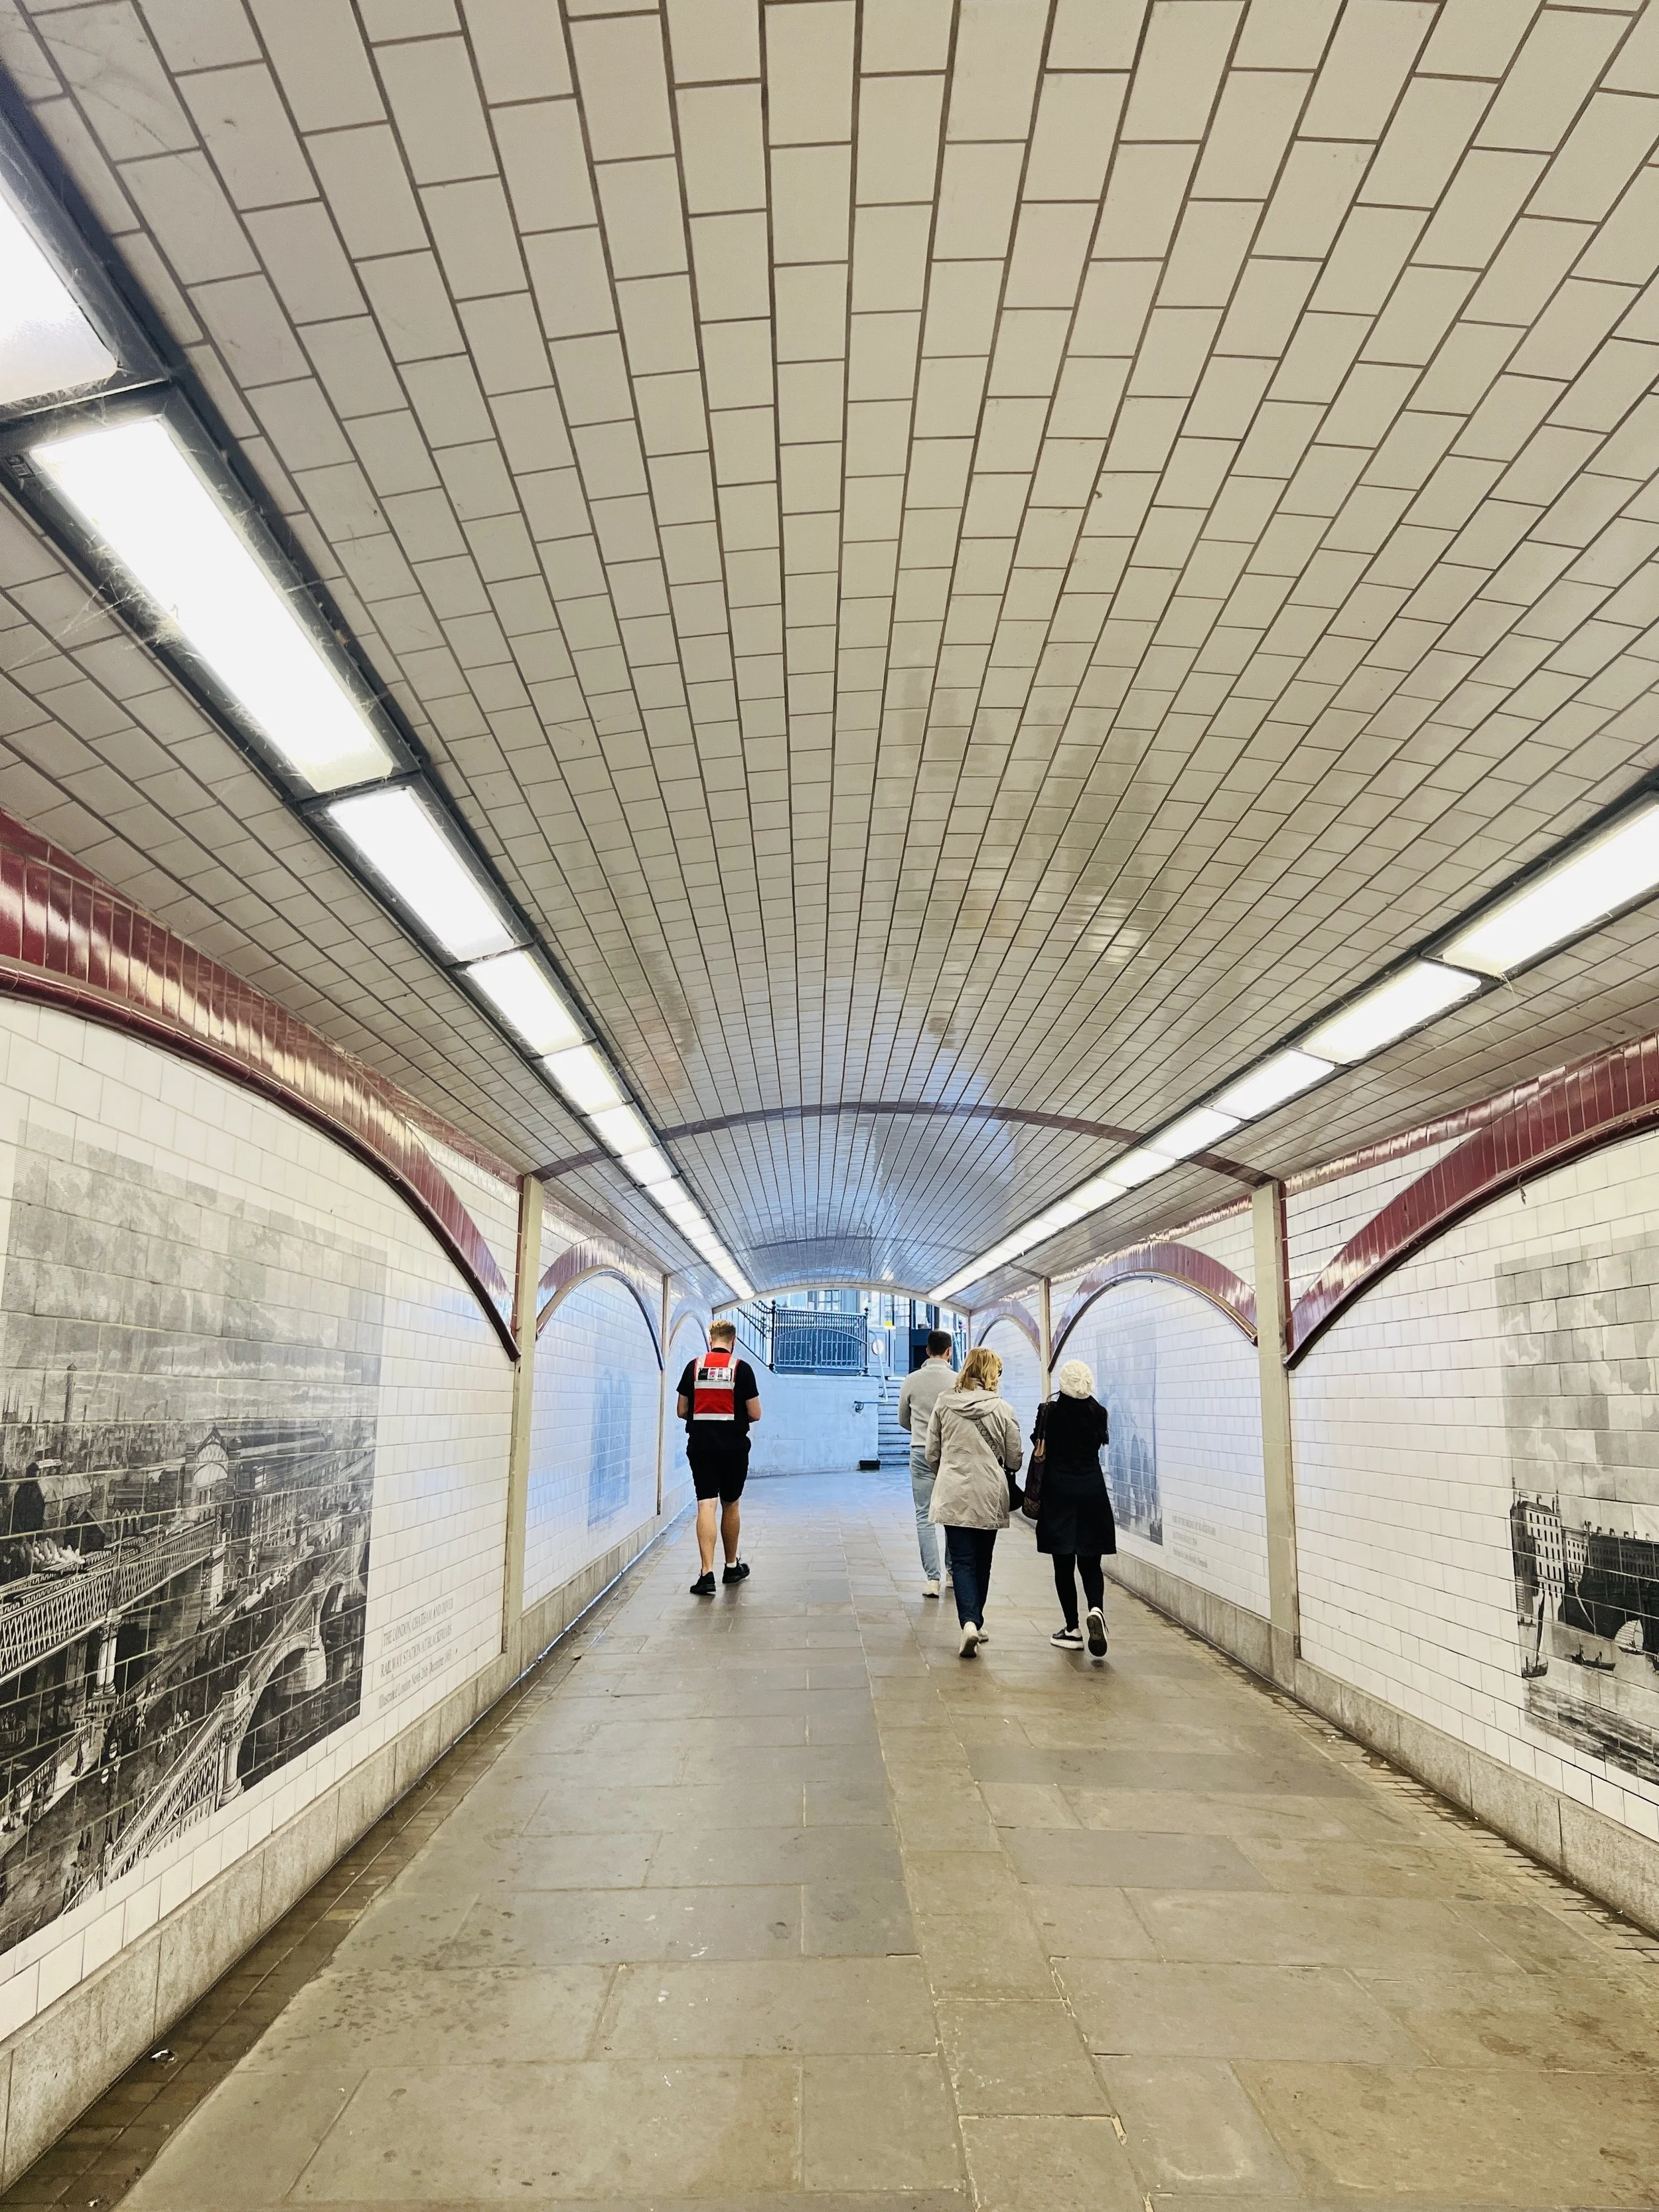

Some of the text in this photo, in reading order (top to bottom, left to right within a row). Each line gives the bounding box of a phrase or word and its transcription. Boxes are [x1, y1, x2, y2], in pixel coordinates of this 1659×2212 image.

[384, 1630, 392, 1647] THE
[433, 1603, 441, 1619] AND
[441, 1597, 453, 1615] DOVER
[380, 1653, 402, 1678] RAILWAY
[403, 1643, 421, 1664] STATION
